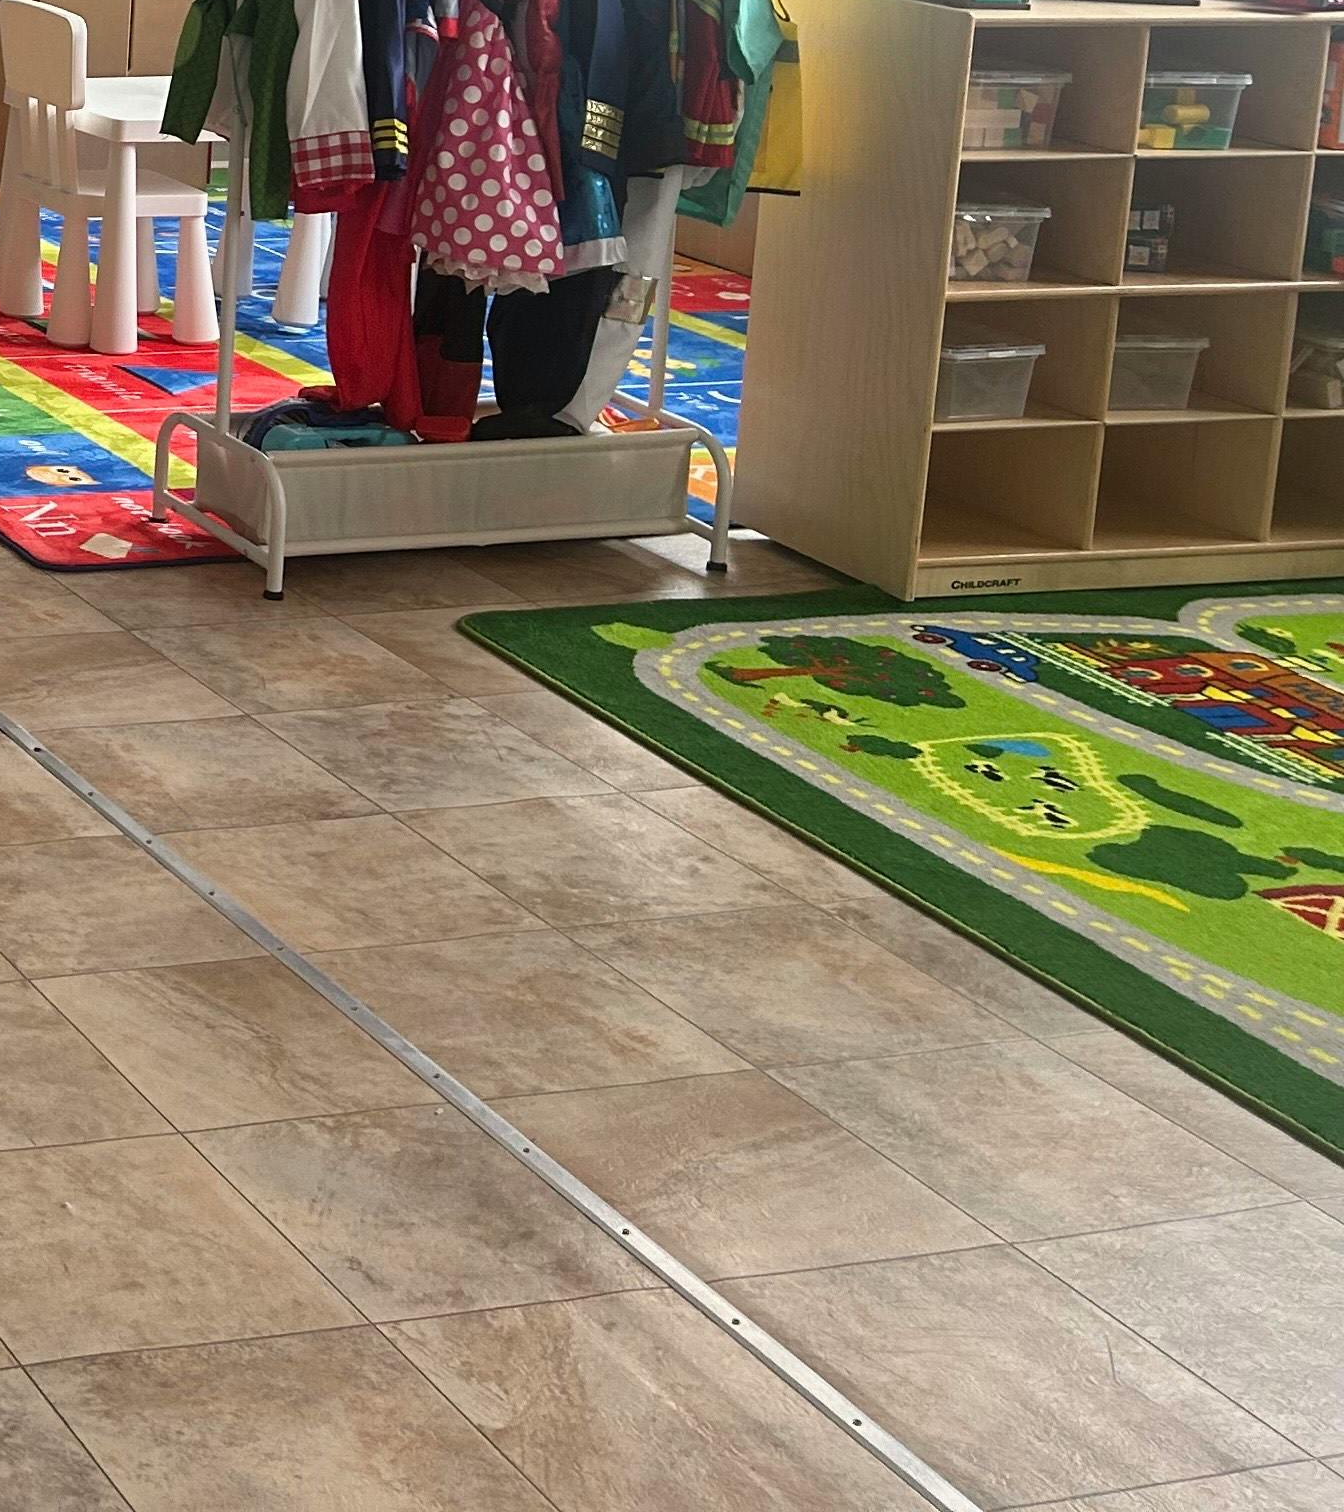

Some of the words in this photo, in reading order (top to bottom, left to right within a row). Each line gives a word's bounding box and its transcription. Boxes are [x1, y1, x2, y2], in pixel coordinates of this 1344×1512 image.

[17, 439, 70, 457] owl
[0, 500, 79, 539] Nn
[951, 578, 1023, 590] CHILDCRAFT
